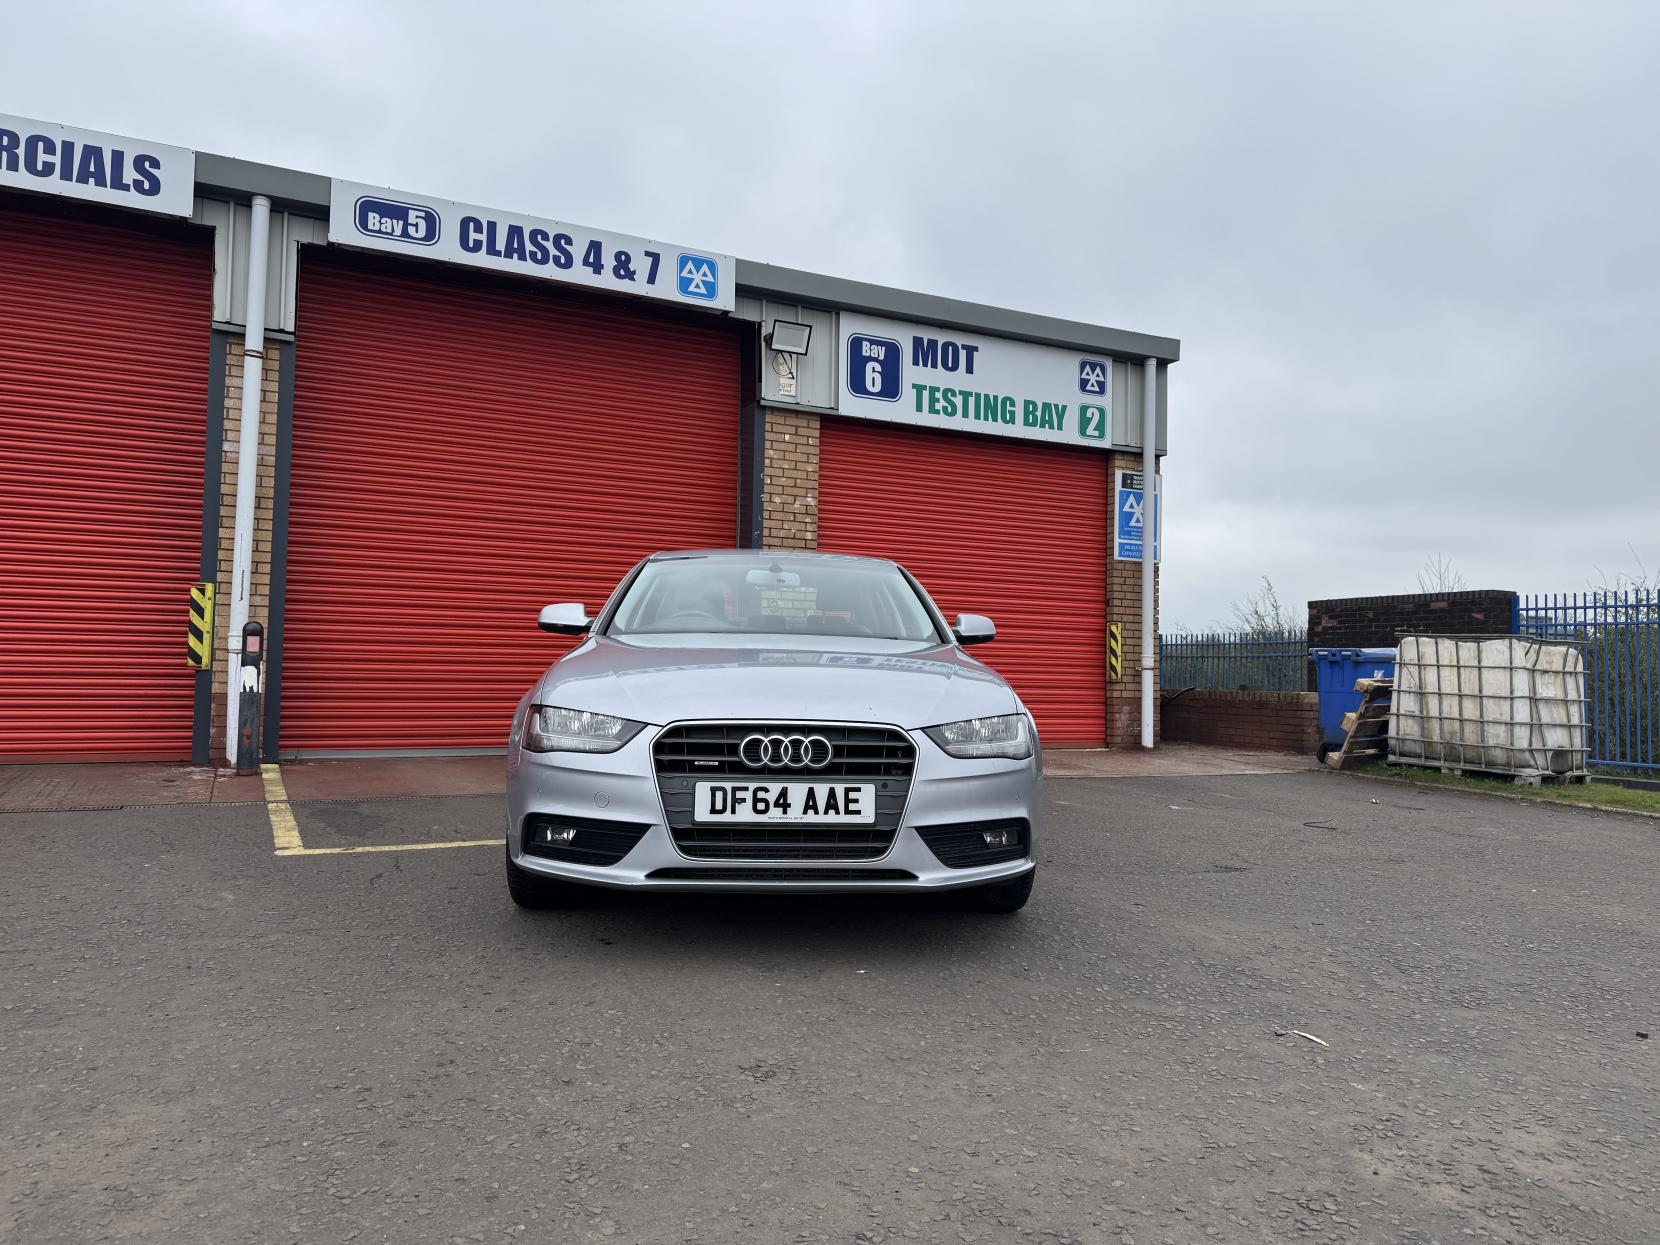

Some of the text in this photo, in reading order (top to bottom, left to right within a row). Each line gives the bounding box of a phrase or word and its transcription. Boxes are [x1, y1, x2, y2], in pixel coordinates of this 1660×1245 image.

[367, 209, 427, 239] Bay 5
[459, 215, 661, 285] CLASS 4 & 7
[862, 340, 886, 361] Bay
[912, 335, 979, 375] MOT
[865, 361, 882, 393] 6
[911, 383, 1068, 432] TESTING BAY
[1085, 407, 1100, 438] 2
[709, 785, 862, 816] DF64 AAE
